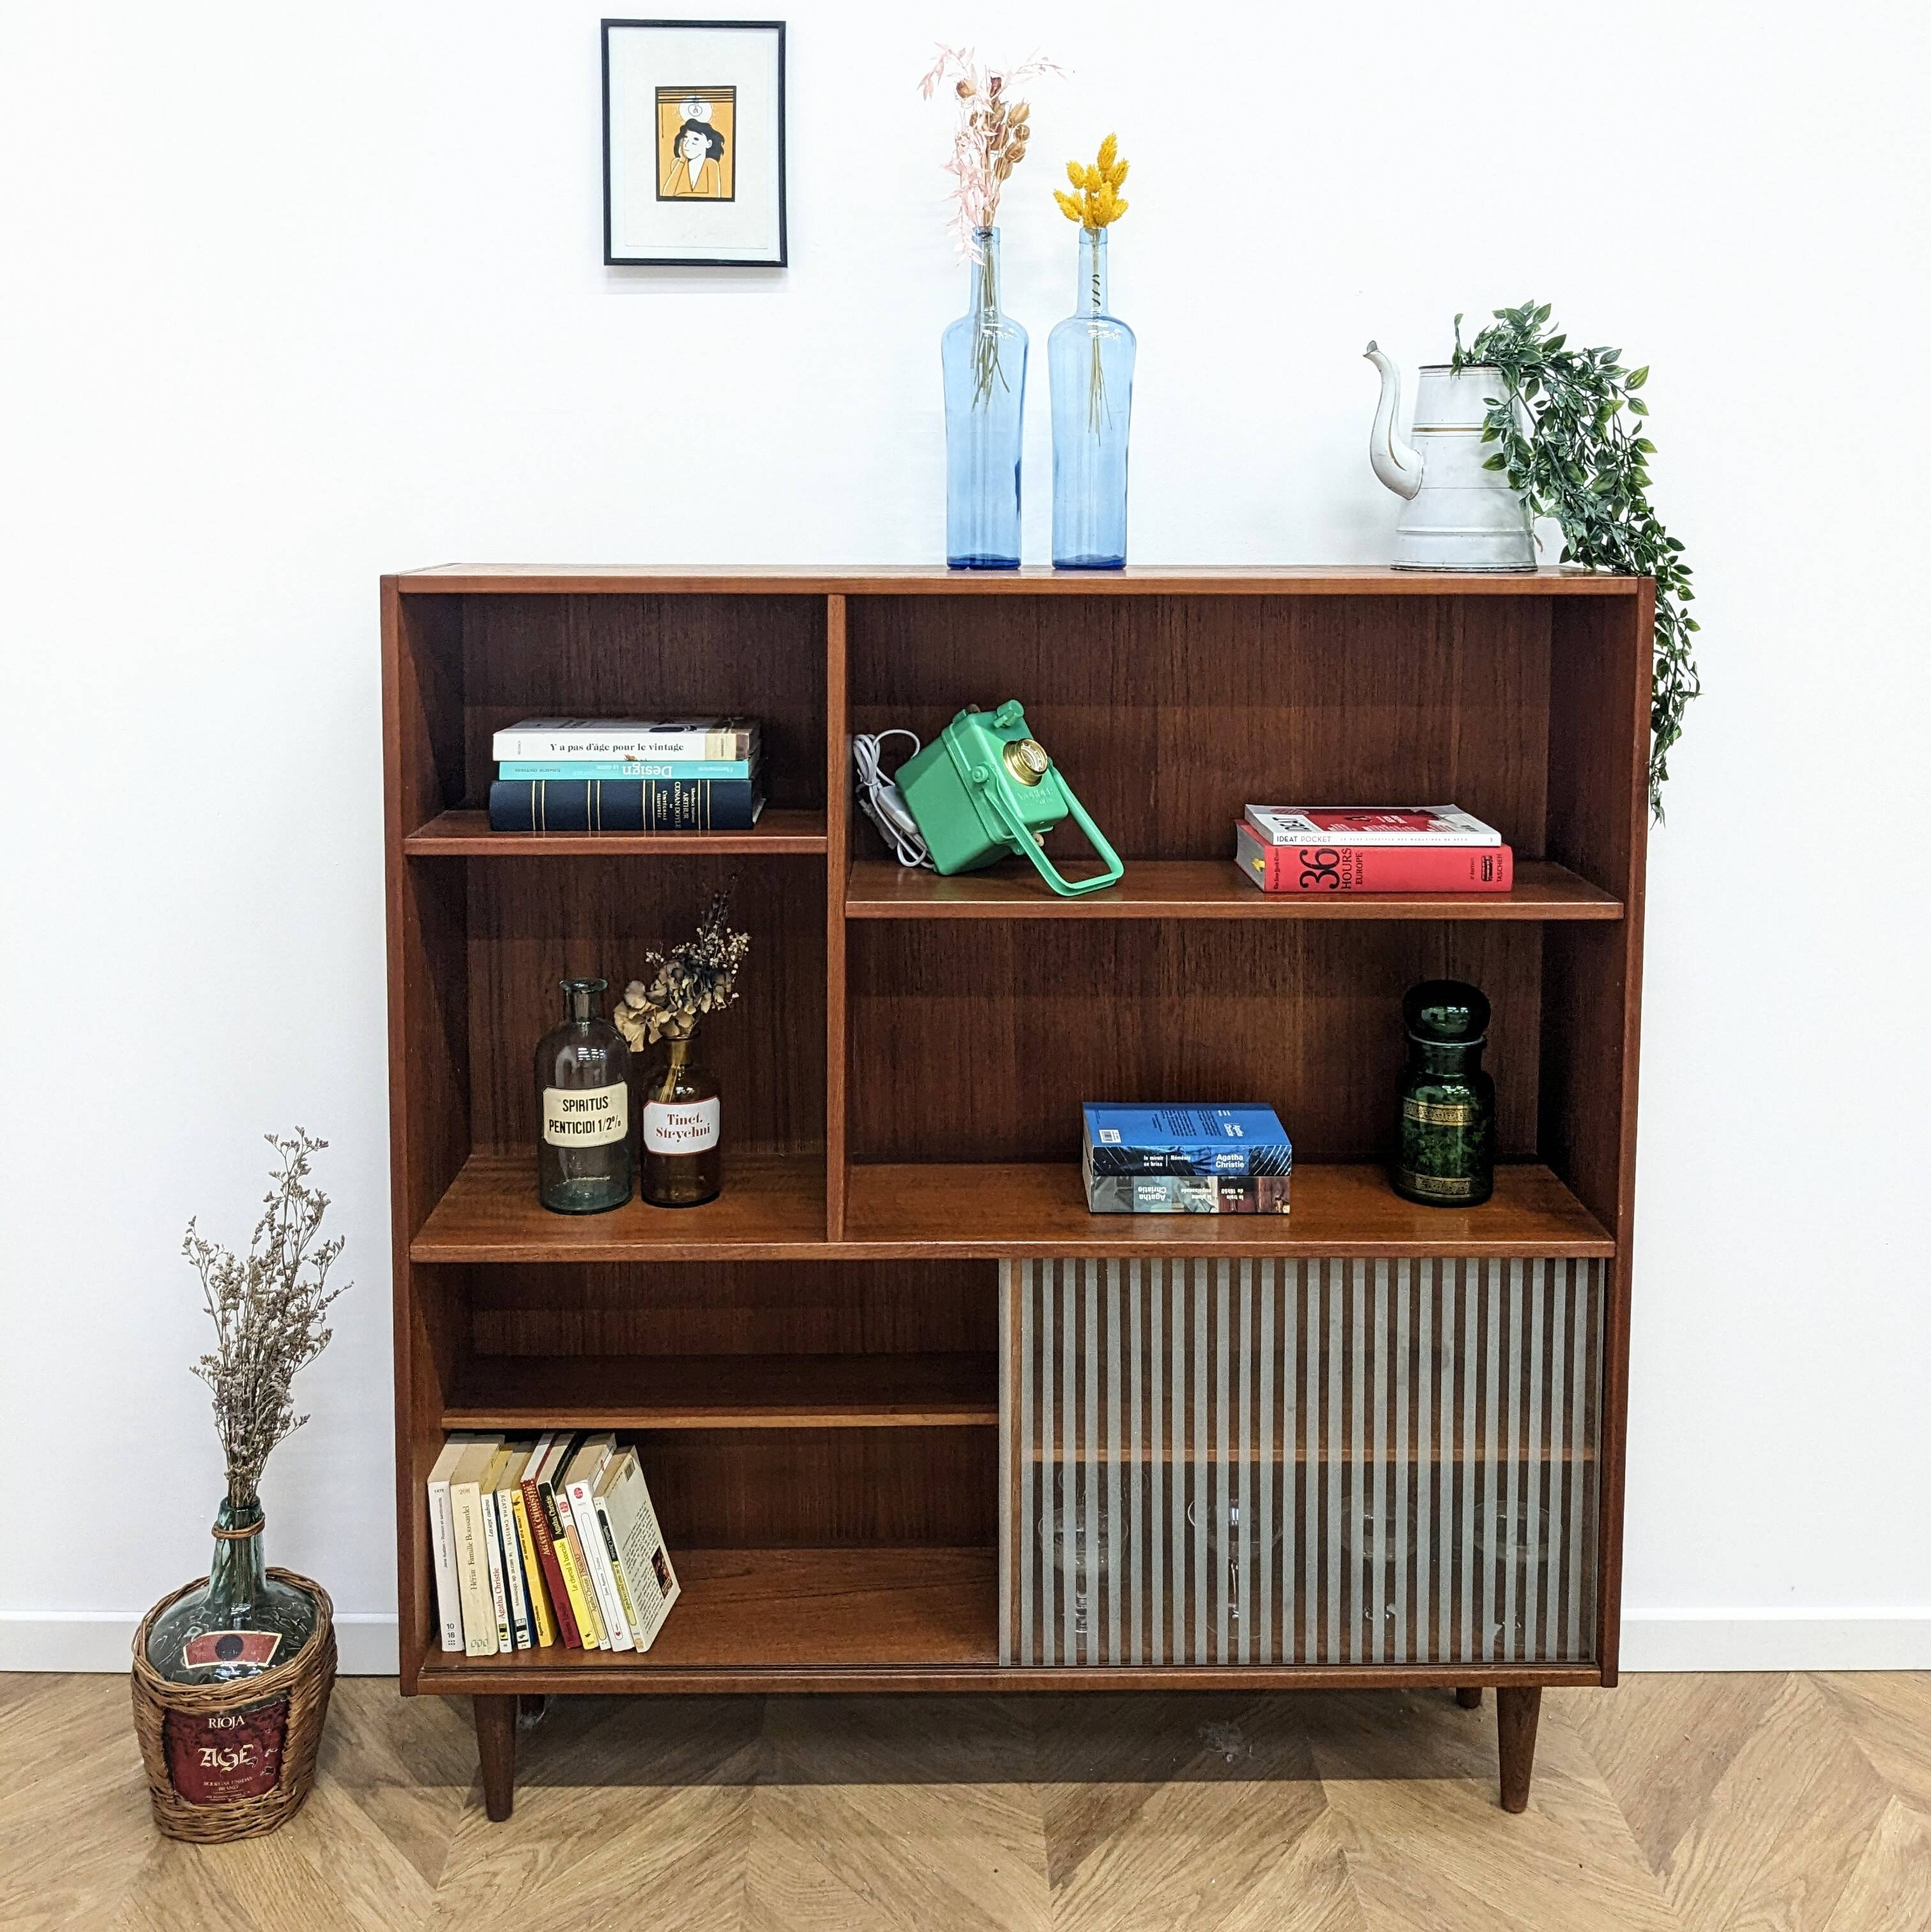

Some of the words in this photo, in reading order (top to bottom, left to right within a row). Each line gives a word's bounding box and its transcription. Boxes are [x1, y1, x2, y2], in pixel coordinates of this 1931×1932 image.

[586, 743, 610, 752] d'âge
[649, 743, 684, 752] vintage
[623, 762, 672, 779] Design
[1299, 848, 1340, 889] 36
[1341, 848, 1352, 889] HOURS
[563, 1096, 609, 1112] SPIRITUS
[549, 1119, 595, 1134] PENTICIDI
[598, 1115, 621, 1132] 1/2%
[656, 1123, 710, 1143] Strychni
[527, 1486, 541, 1523] CHRISTIE
[547, 1495, 556, 1516] Christie
[463, 1506, 473, 1540] Boussardel
[504, 1520, 512, 1546] CHRISTIE
[552, 1516, 563, 1535] Agatha
[535, 1523, 550, 1555] AGATHA
[467, 1542, 475, 1565] Famille
[559, 1542, 570, 1562] bascule
[608, 1541, 617, 1559] Christie
[493, 1568, 502, 1594] Christie
[566, 1567, 576, 1585] cheval
[584, 1578, 592, 1596] Christie
[497, 1595, 506, 1619] Agatha
[588, 1596, 597, 1612] Agatha
[209, 1715, 245, 1730] RIOJA
